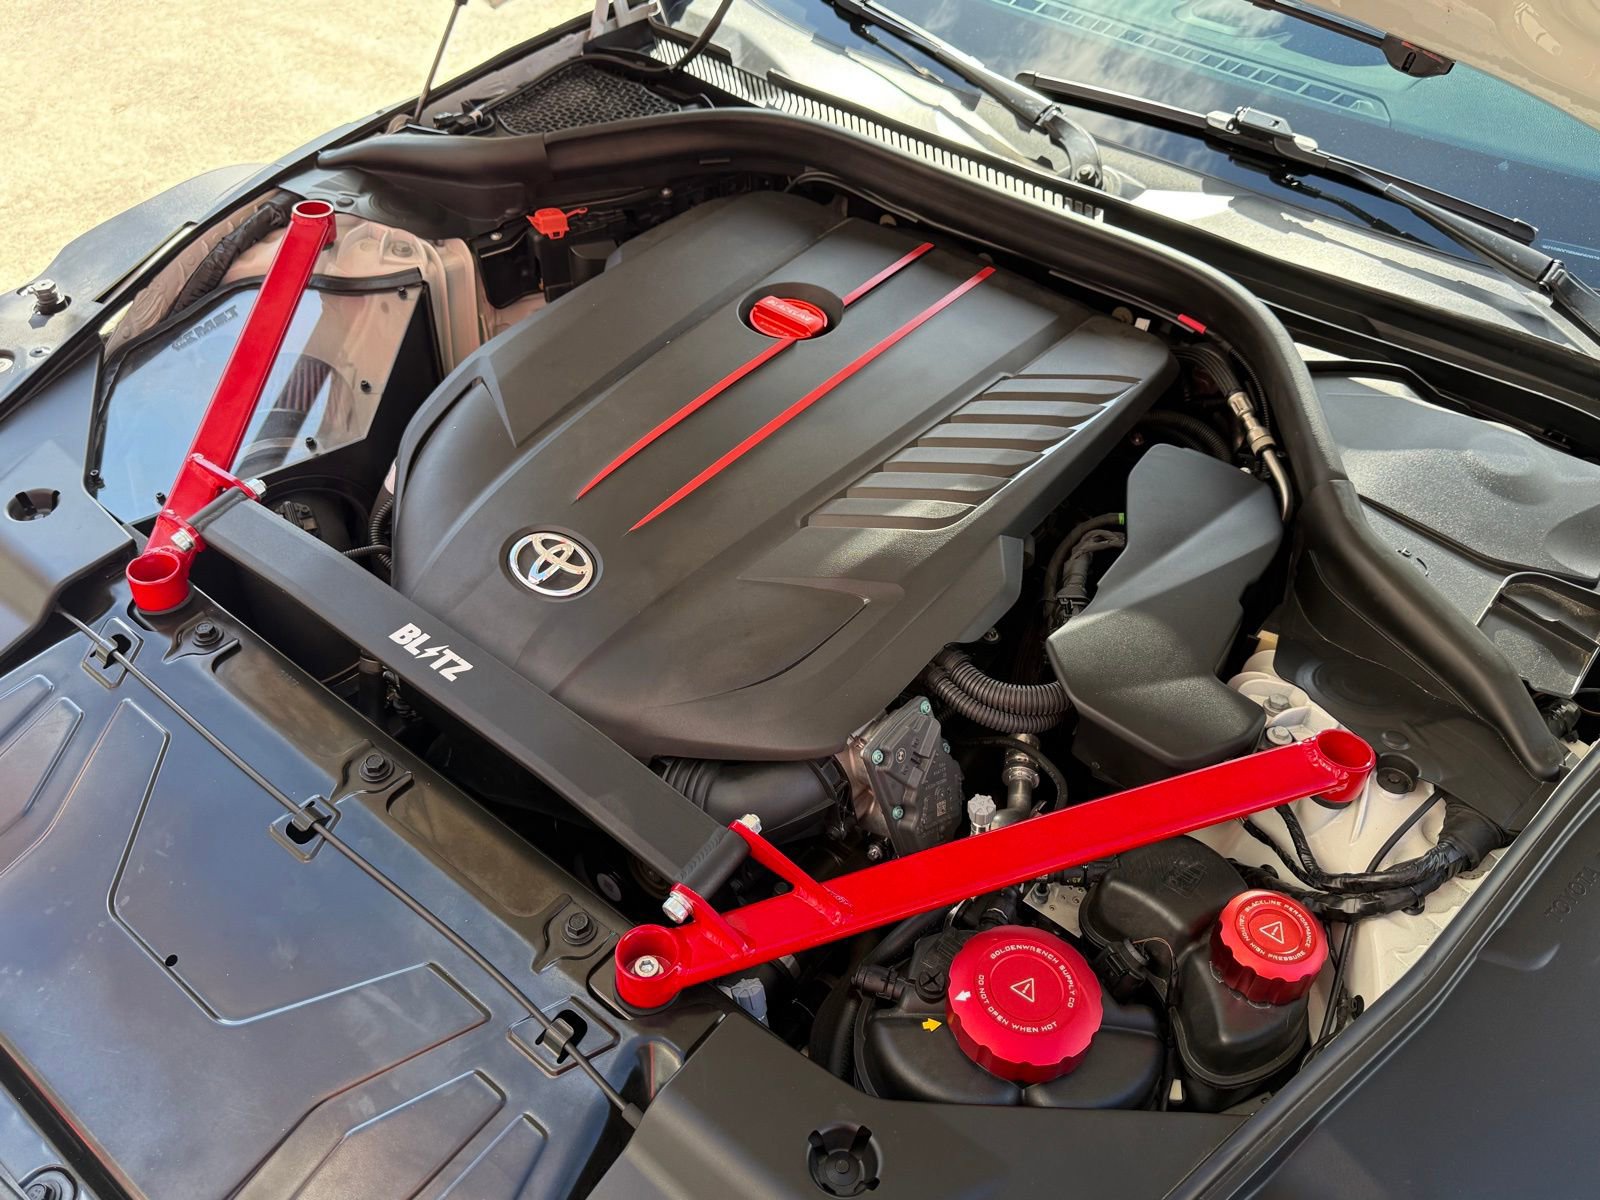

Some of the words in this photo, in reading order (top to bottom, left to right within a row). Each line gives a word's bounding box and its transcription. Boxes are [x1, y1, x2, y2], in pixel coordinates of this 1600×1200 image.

[388, 622, 474, 682] BLITZ
[1244, 899, 1282, 913] BLACKLINE
[1283, 904, 1312, 948] PERFORMANCE
[1239, 914, 1250, 942] CAUTION
[1249, 942, 1266, 956] HIGH
[1267, 949, 1306, 962] PRESSURE
[990, 944, 1059, 964] GOLDENWRENCH
[977, 974, 985, 986] DO
[1058, 964, 1078, 997] SUPPLY
[977, 987, 990, 1005] NOT
[1067, 997, 1077, 1009] CO
[987, 1006, 1009, 1026] OPEN
[1041, 1020, 1058, 1032] HOT
[1011, 1023, 1040, 1034] WHEN
